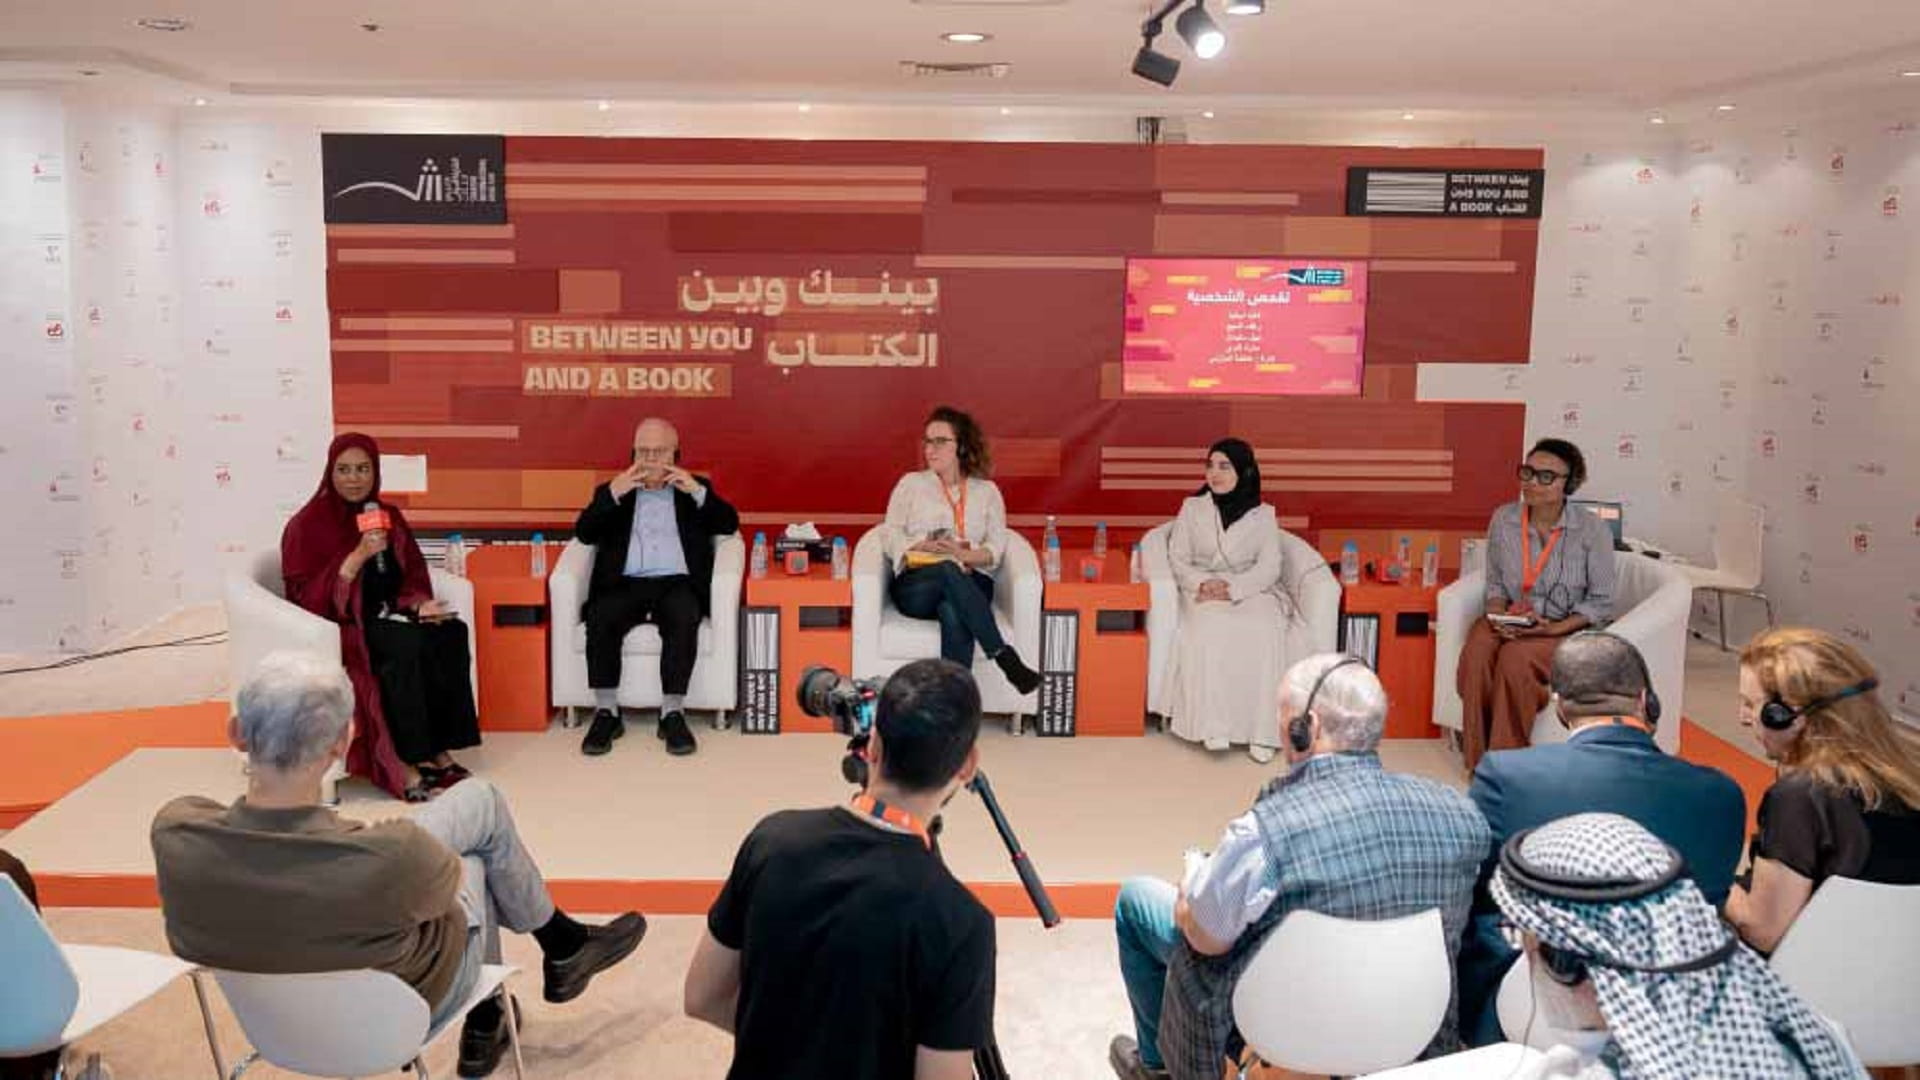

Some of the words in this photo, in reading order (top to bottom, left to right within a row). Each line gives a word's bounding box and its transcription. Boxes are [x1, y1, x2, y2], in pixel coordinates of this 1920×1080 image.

[1451, 173, 1507, 185] BETWEEN
[1476, 188, 1501, 199] YOU
[1503, 189, 1529, 200] AND
[1449, 201, 1458, 212] A
[1460, 202, 1493, 213] BOOK
[682, 269, 788, 316] وبين
[530, 325, 682, 350] BETWEEN
[689, 327, 753, 350] YOU
[767, 331, 938, 376] الكتاب
[523, 367, 591, 391] AND
[598, 367, 620, 391] A
[627, 367, 715, 391] BOOK
